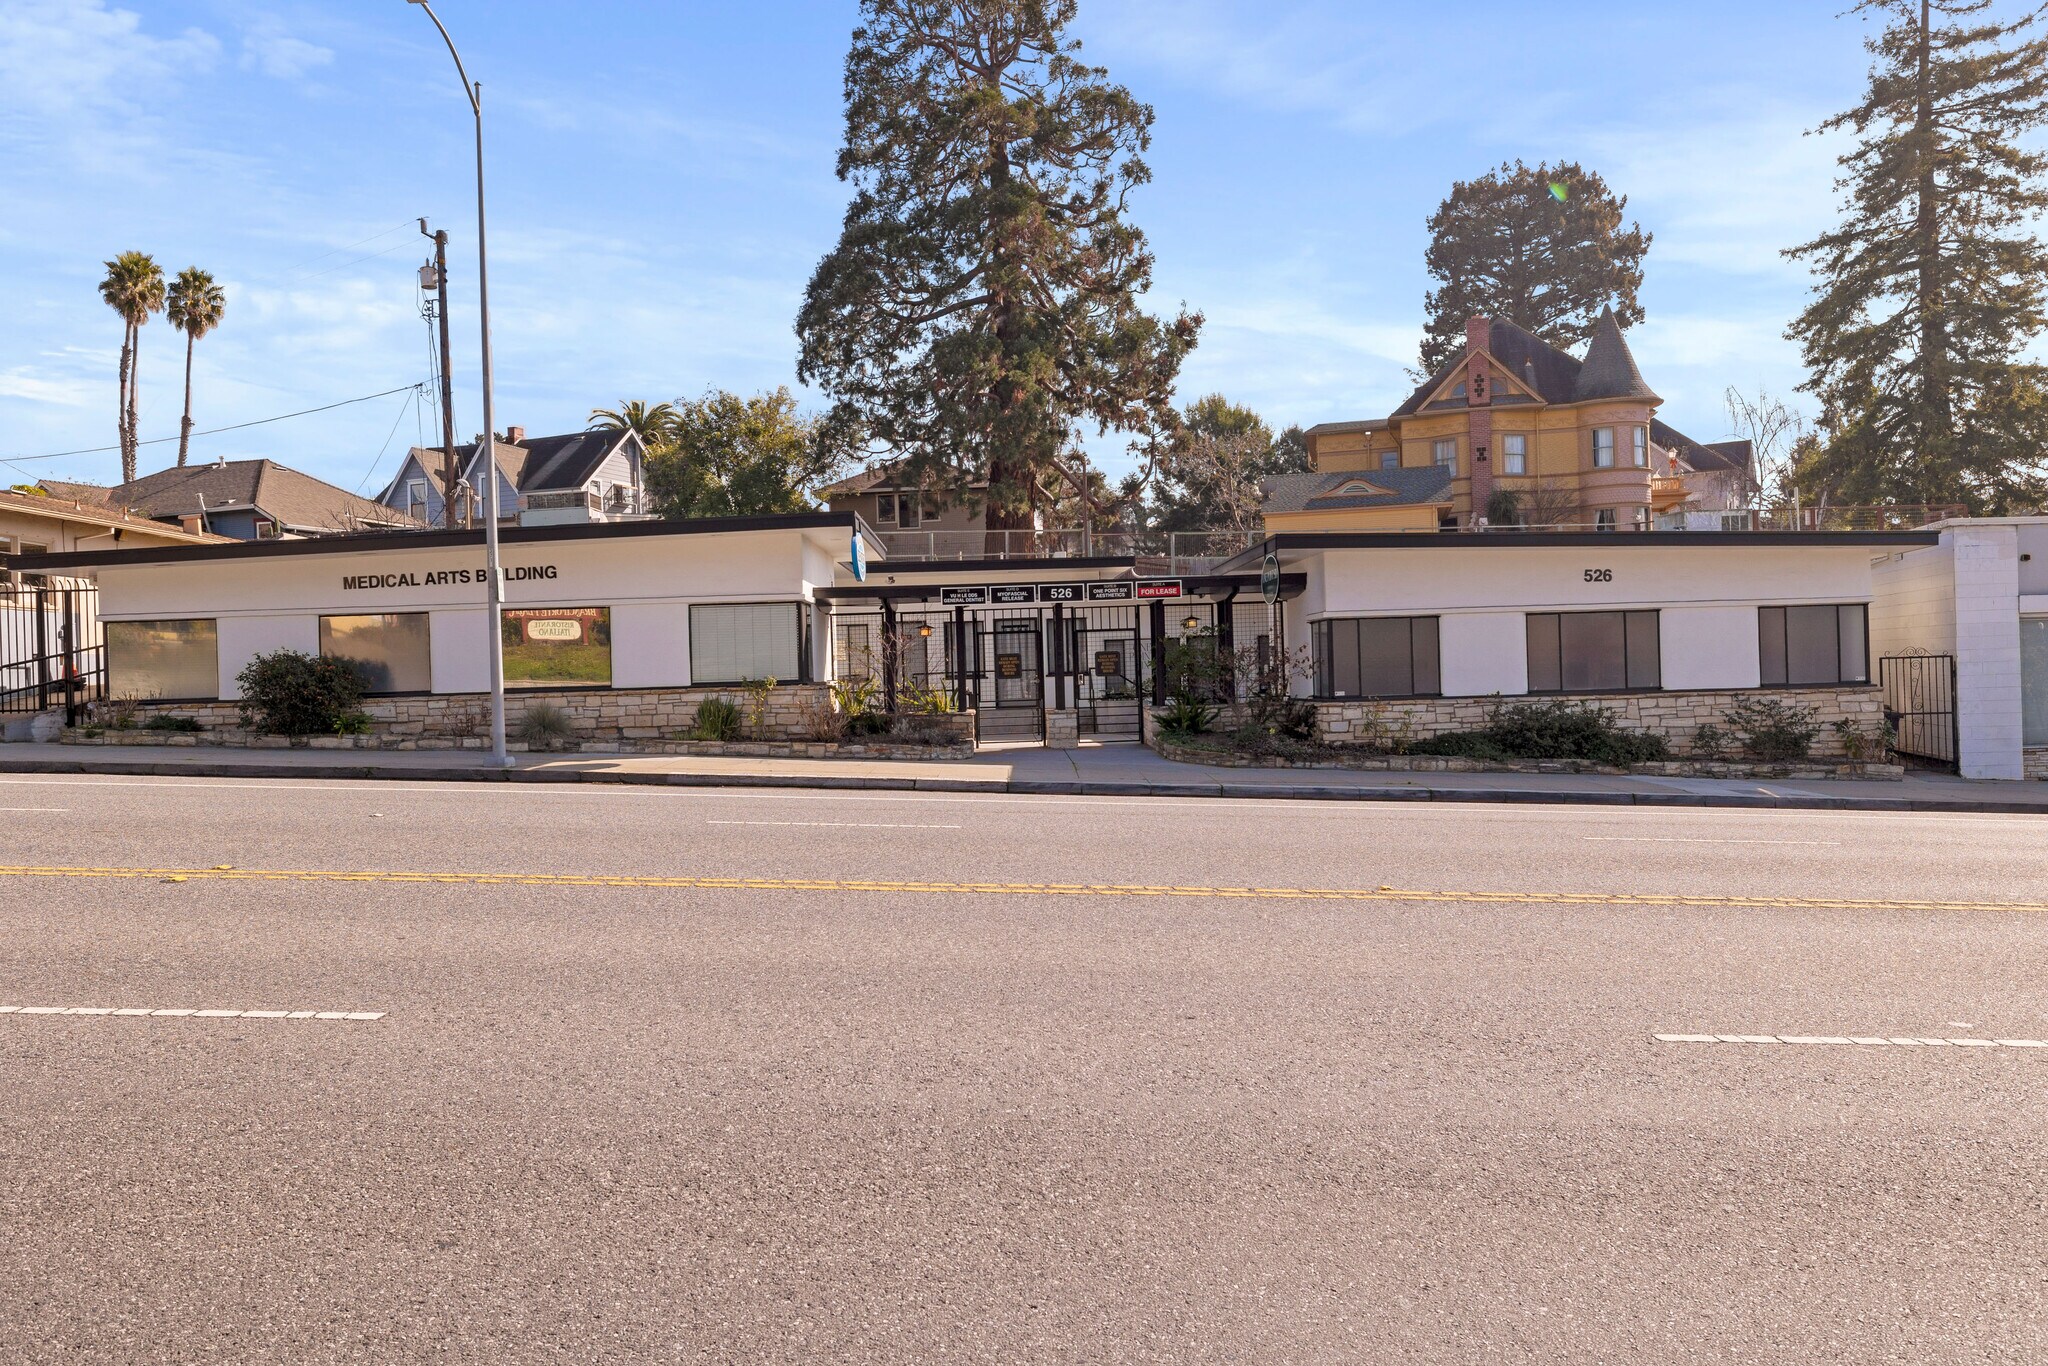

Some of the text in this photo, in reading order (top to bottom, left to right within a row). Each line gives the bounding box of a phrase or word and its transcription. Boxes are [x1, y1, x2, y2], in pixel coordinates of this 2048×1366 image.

[342, 565, 558, 590] MEDICAL ARTS BLDING
[1583, 568, 1613, 583] 526
[1050, 588, 1073, 599] 526
